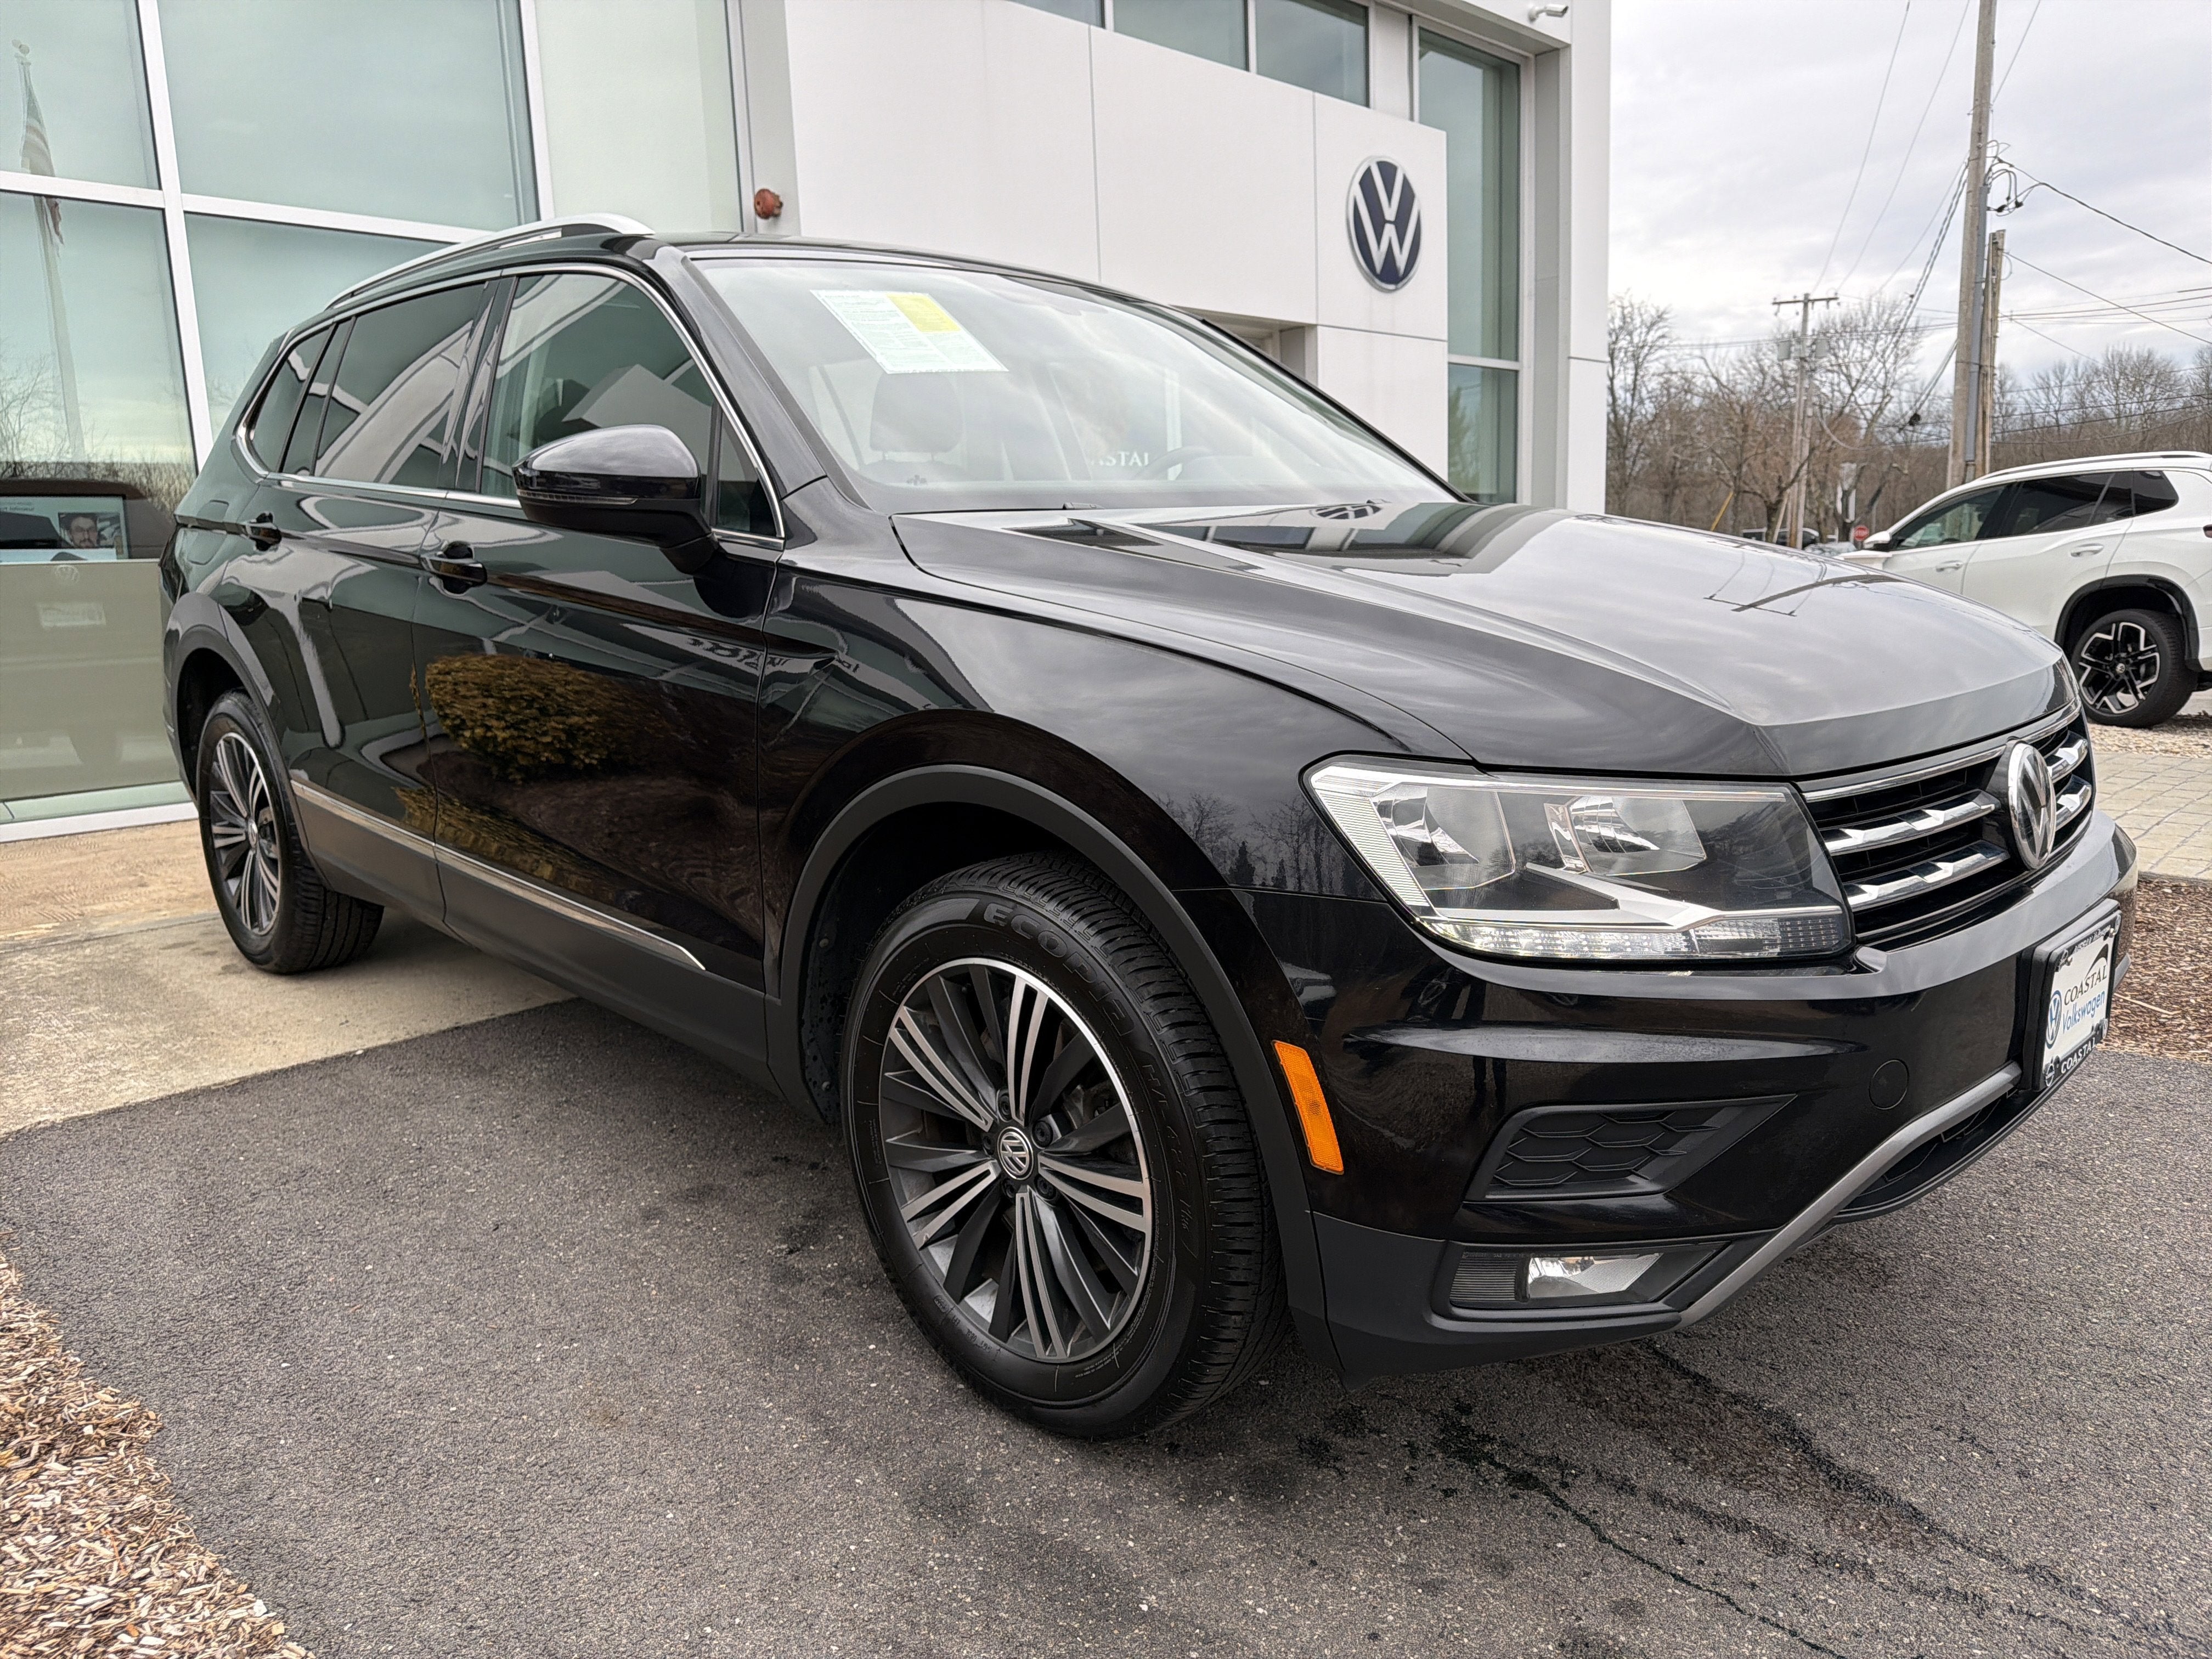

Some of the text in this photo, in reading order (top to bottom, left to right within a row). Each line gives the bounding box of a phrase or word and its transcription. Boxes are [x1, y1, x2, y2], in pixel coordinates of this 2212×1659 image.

[1348, 157, 1421, 291] VW
[2064, 965, 2107, 1005] COASTAL
[2063, 991, 2105, 1034] Volkswagen
[2061, 1037, 2096, 1074] COASTAL
